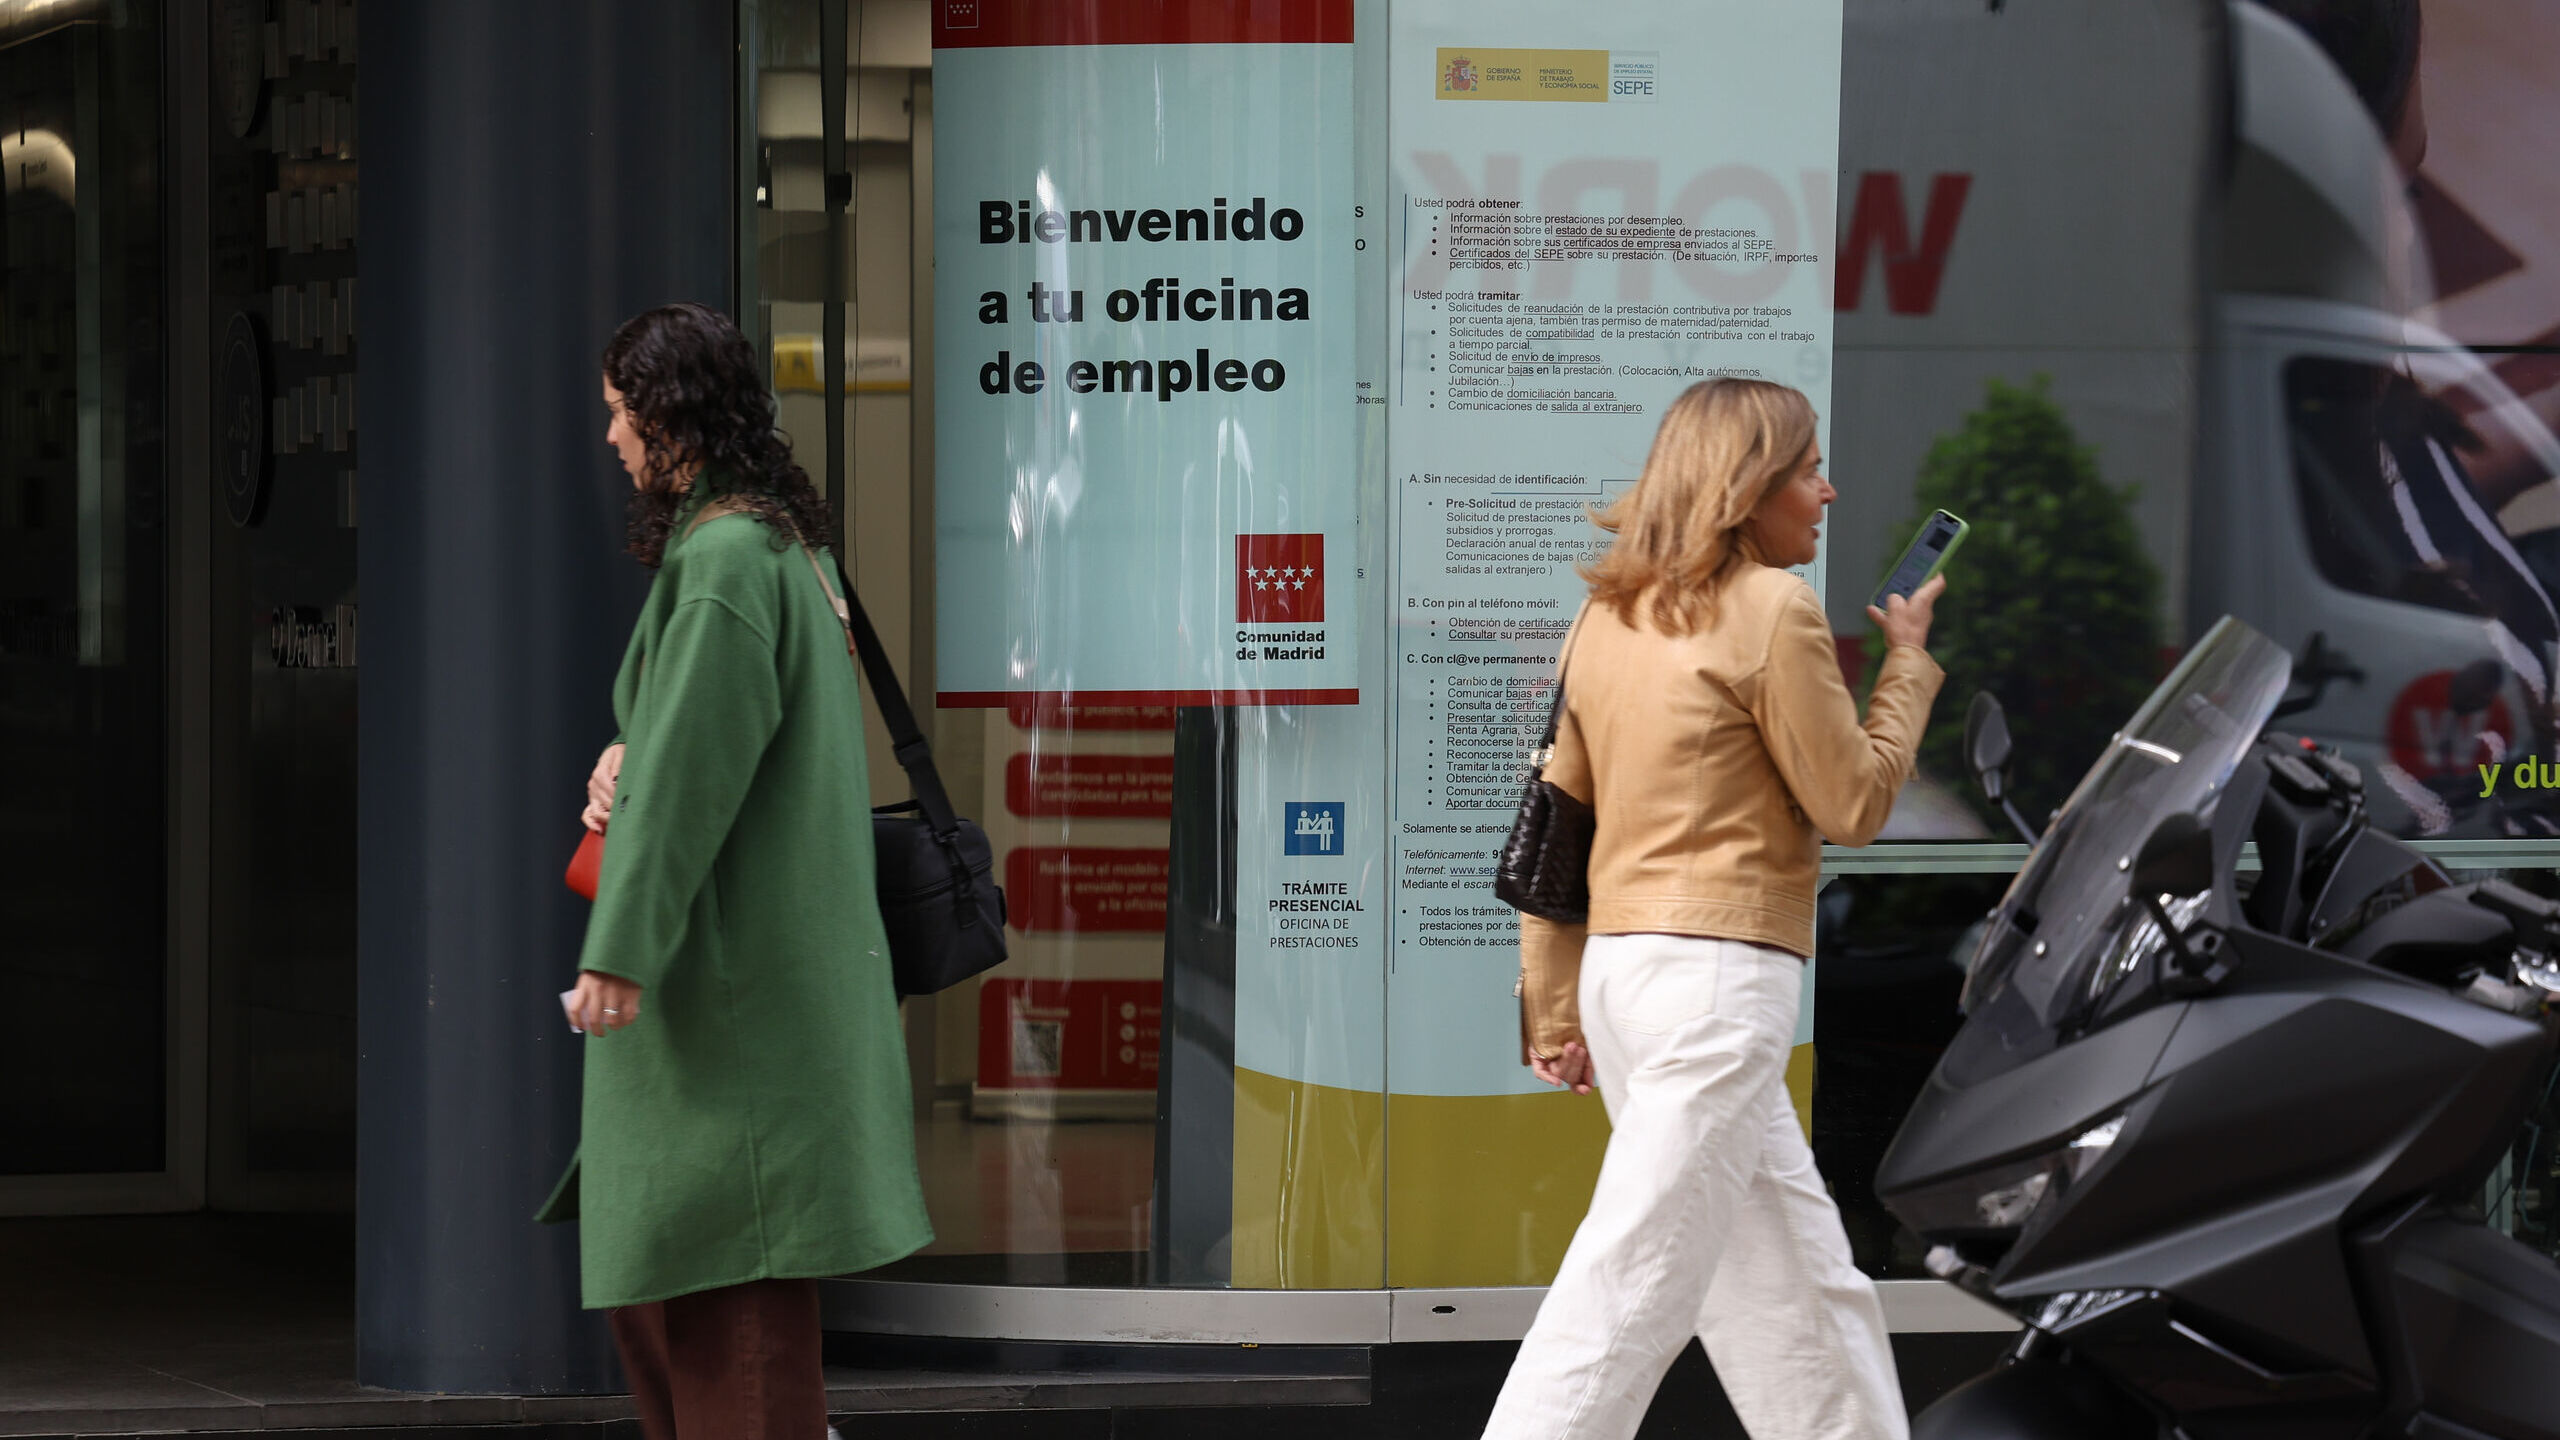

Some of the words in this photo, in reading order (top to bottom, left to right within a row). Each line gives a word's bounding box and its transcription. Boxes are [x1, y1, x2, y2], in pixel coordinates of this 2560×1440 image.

[1614, 81, 1654, 95] SEPE
[1414, 197, 1442, 208] Usted
[1446, 197, 1474, 210] podrá
[1478, 198, 1524, 208] obtener:
[979, 198, 1304, 244] Bienvenido
[1450, 212, 1510, 223] Información
[1513, 213, 1541, 223] sobre
[1544, 213, 1604, 226] prestaciones
[1608, 216, 1624, 227] por
[1626, 214, 1685, 227] desempleo.
[1450, 224, 1510, 235] Información
[1513, 224, 1541, 235] sobre
[1544, 225, 1552, 235] el
[1555, 225, 1587, 236] estado
[1590, 225, 1602, 236] de
[1605, 228, 1617, 236] su
[1620, 226, 1675, 239] expediente
[1678, 226, 1691, 237] de
[1694, 226, 1758, 240] prestaciones.
[1450, 236, 1510, 246] Información
[1513, 236, 1541, 247] sobre
[1543, 239, 1560, 247] sus
[1563, 237, 1618, 248] certificados
[1621, 237, 1634, 248] de
[1636, 240, 1681, 251] empresa
[1684, 238, 1728, 249] enviados
[1731, 238, 1740, 249] al
[1743, 239, 1776, 249] SEPE.
[1449, 248, 1510, 258] Certificados
[1514, 248, 1529, 259] del
[1534, 248, 1563, 259] SEPE
[1567, 249, 1593, 259] sobre
[1597, 252, 1608, 260] su
[1612, 249, 1668, 263] prestación.
[1672, 250, 1691, 263] (De
[1693, 250, 1739, 262] situación,
[1744, 251, 1771, 263] IRPF,
[1774, 251, 1818, 264] importes
[1449, 259, 1503, 272] percibidos,
[1507, 259, 1530, 272] etc.)
[978, 290, 1008, 324] a
[1028, 282, 1083, 322] tu
[1106, 277, 1310, 322] oficina
[1413, 289, 1442, 300] Usted
[1445, 289, 1473, 302] podrá
[1477, 290, 1523, 300] tramitar:
[1448, 302, 1502, 313] Solicitudes
[1507, 302, 1520, 313] de
[1523, 303, 1584, 314] reanudación
[1587, 303, 1600, 314] de
[1604, 303, 1612, 314] la
[1616, 304, 1668, 317] prestación
[1672, 304, 1729, 315] contributiva
[1733, 307, 1749, 318] por
[1753, 304, 1792, 318] trabajos
[980, 350, 1044, 394] de
[1066, 348, 1286, 402] empleo
[1448, 387, 1488, 398] Cambio
[1490, 388, 1503, 398] de
[1506, 388, 1570, 398] domiciliación
[1573, 388, 1617, 399] bancaria.
[1448, 400, 1532, 411] Comunicaciones
[1535, 401, 1548, 411] de
[1550, 401, 1578, 412] salida
[1582, 401, 1590, 412] al
[1593, 401, 1645, 414] extranjero.
[1423, 473, 1440, 484] Sin
[1444, 473, 1495, 484] necesidad
[1499, 474, 1511, 484] de
[1514, 474, 1588, 484] identificación:
[1446, 498, 1515, 509] Pre-Solicitud
[1519, 498, 1532, 509] de
[1535, 498, 1584, 512] prestación
[1446, 524, 1493, 535] subsidios
[1505, 528, 1556, 538] prorrogas.
[1422, 597, 1444, 608] Con
[1447, 597, 1464, 610] pin
[1467, 597, 1476, 608] al
[1480, 598, 1523, 608] teléfono
[1526, 598, 1559, 608] móvil:
[1448, 617, 1500, 628] Obtención
[1503, 617, 1516, 628] de
[1236, 631, 1324, 642] Comunidad
[1448, 629, 1496, 639] Consultar
[1514, 629, 1566, 642] prestación
[1236, 648, 1256, 660] de
[1264, 647, 1324, 660] Madrid
[1421, 653, 1443, 664] Con
[1446, 653, 1480, 666] cl@ve
[1482, 653, 1546, 666] permanente
[1447, 712, 1495, 723] Presentar
[2478, 764, 2501, 798] y
[1402, 822, 1457, 833] Solamente
[1460, 825, 1471, 833] se
[1475, 822, 1511, 833] atiende
[1402, 848, 1487, 859] Telefónicamente:
[1405, 864, 1445, 874] Internet:
[1282, 880, 1347, 895] TRÁMITE
[1402, 878, 1448, 889] Mediante
[1450, 878, 1459, 889] el
[1269, 900, 1364, 912] PRESENCIAL
[1420, 905, 1450, 916] Todos
[1454, 905, 1468, 916] los
[1472, 905, 1511, 916] trámites
[1280, 918, 1330, 929] OFICINA
[1333, 919, 1349, 929] DE
[1419, 920, 1482, 933] prestaciones
[1486, 923, 1502, 933] por
[1270, 937, 1358, 948] PRESTACIONES
[1419, 935, 1470, 946] Obtención
[1473, 935, 1486, 946] de
